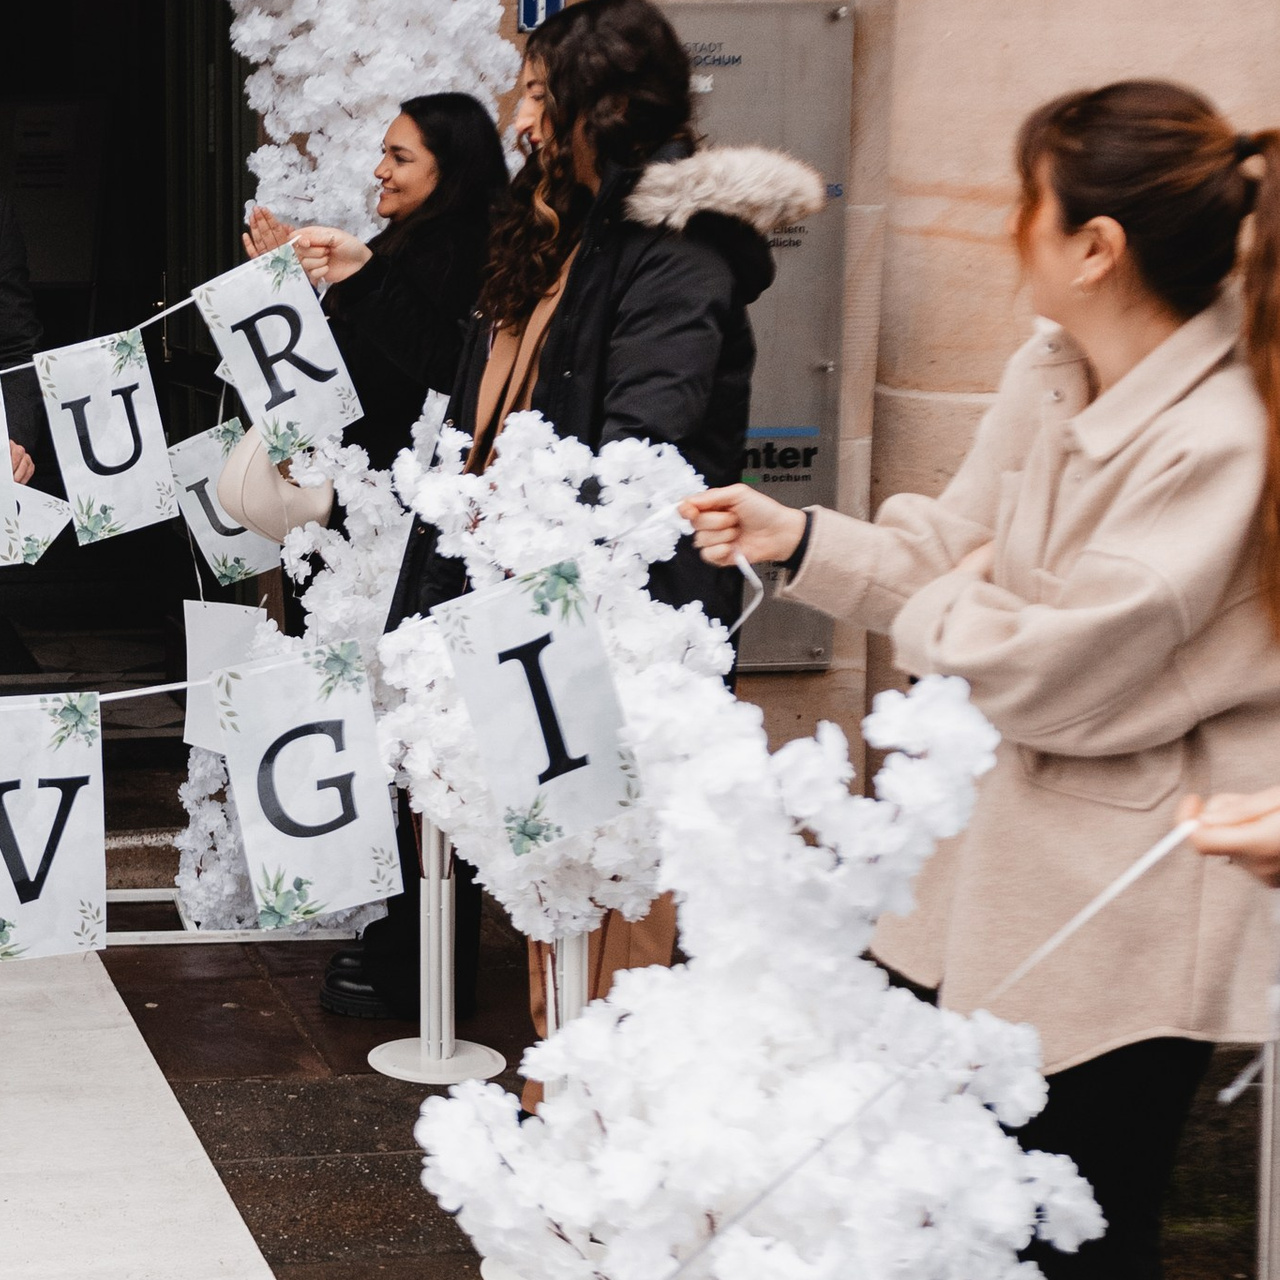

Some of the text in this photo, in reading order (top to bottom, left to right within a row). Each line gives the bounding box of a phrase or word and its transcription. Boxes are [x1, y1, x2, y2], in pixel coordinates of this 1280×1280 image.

[682, 42, 725, 53] STADT
[690, 55, 742, 66] OCHUM
[768, 237, 802, 248] dliche
[740, 442, 819, 469] nter
[762, 473, 812, 483] Bochum
